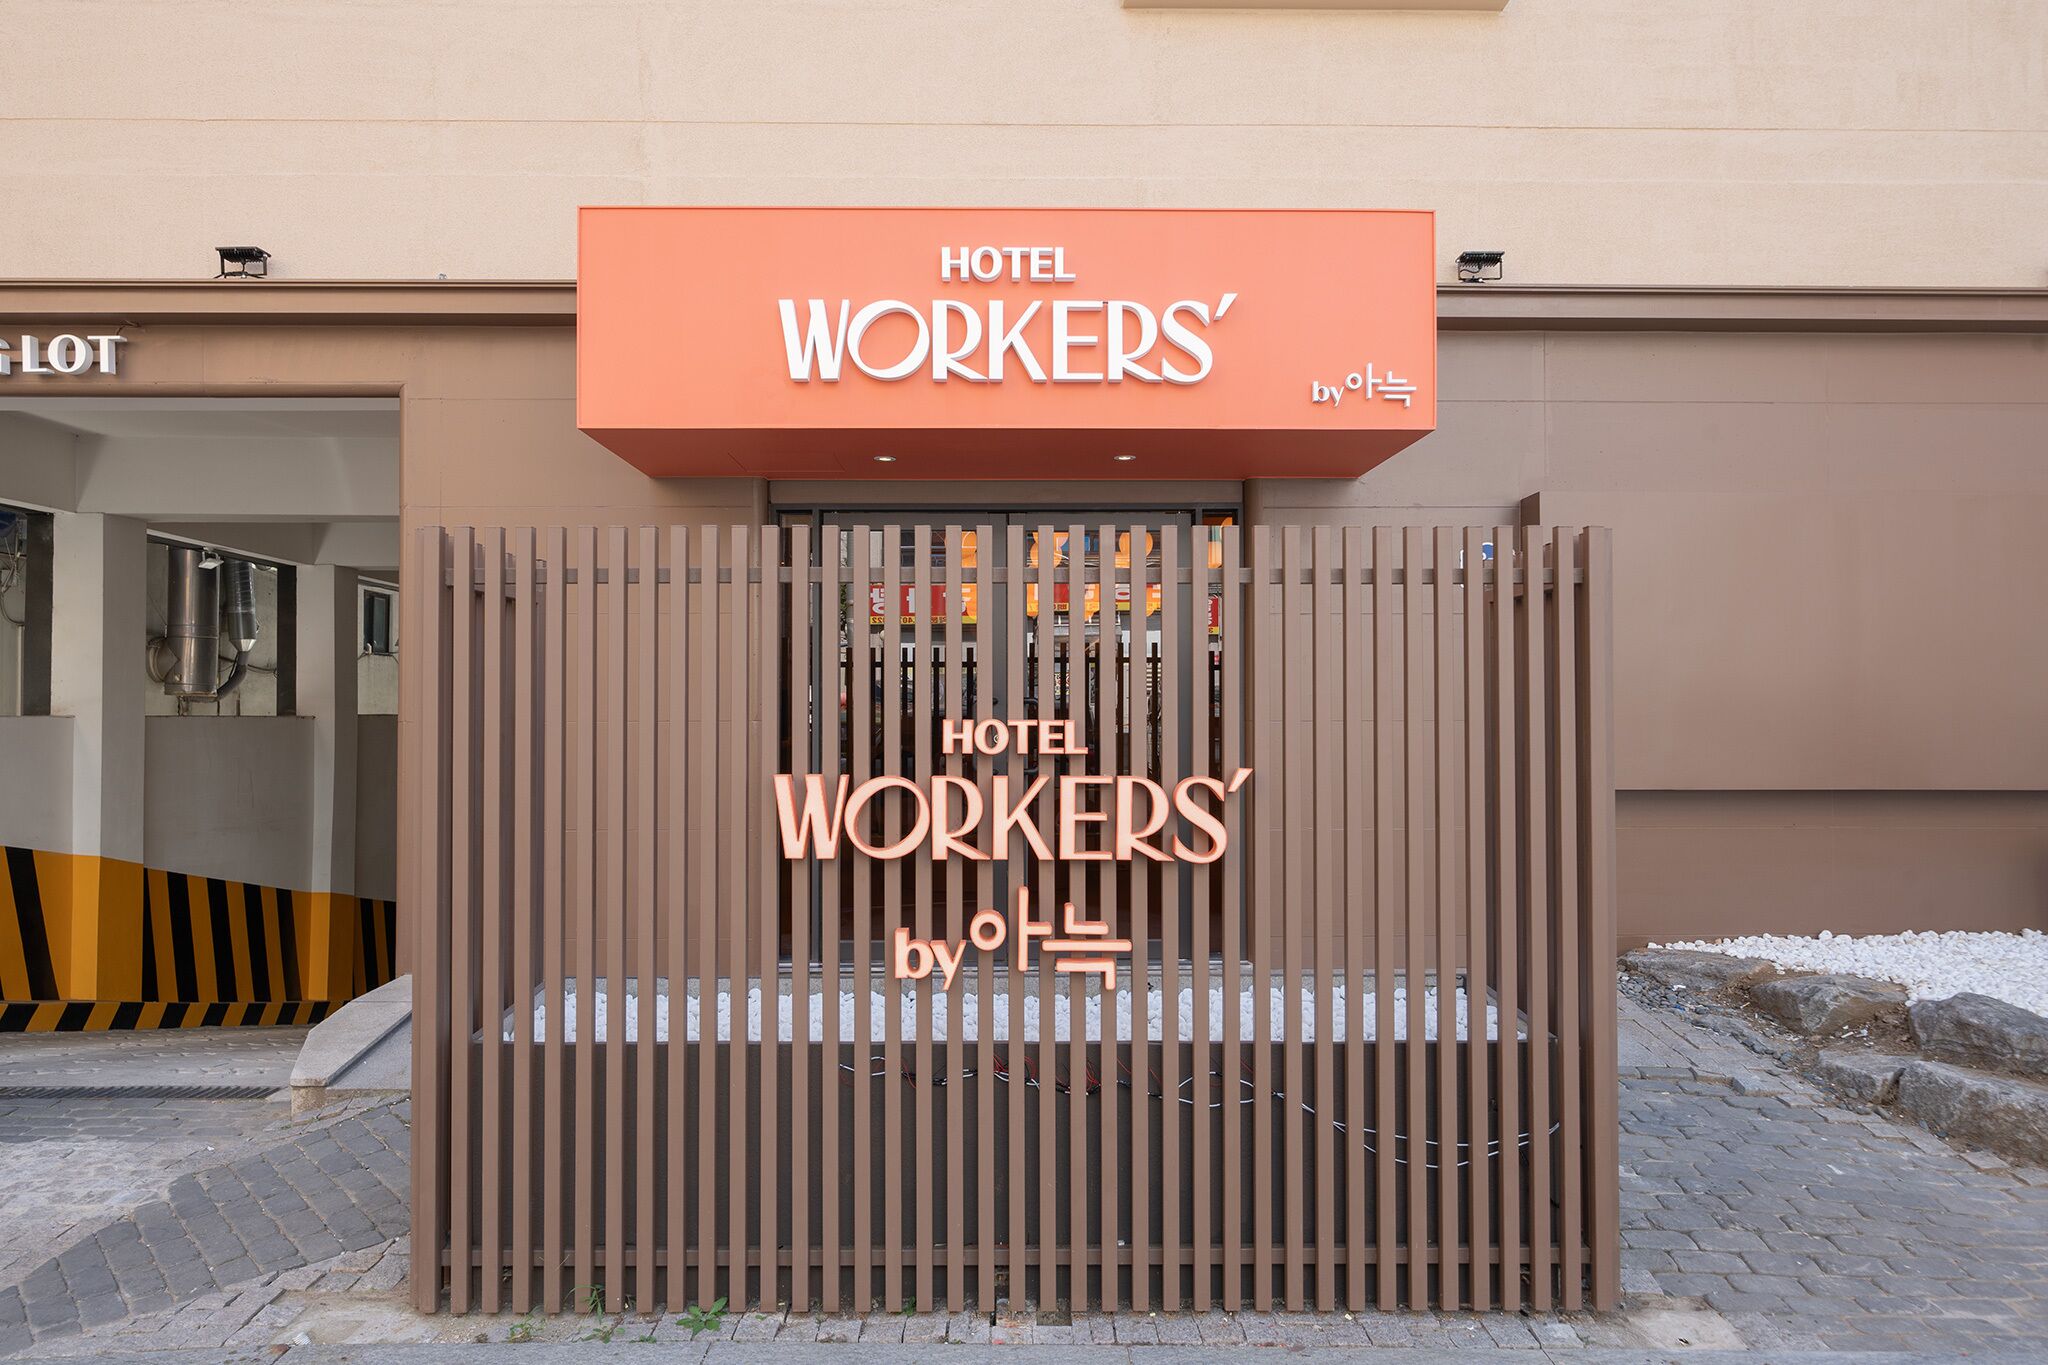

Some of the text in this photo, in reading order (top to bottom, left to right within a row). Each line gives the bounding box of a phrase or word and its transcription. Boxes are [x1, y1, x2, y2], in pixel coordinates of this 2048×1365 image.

[941, 246, 1076, 282] HOTEL
[21, 334, 127, 375] LOT
[778, 292, 1238, 383] WORKERS'
[942, 718, 1088, 755] HOTEL
[773, 767, 1254, 864] WORKERS'
